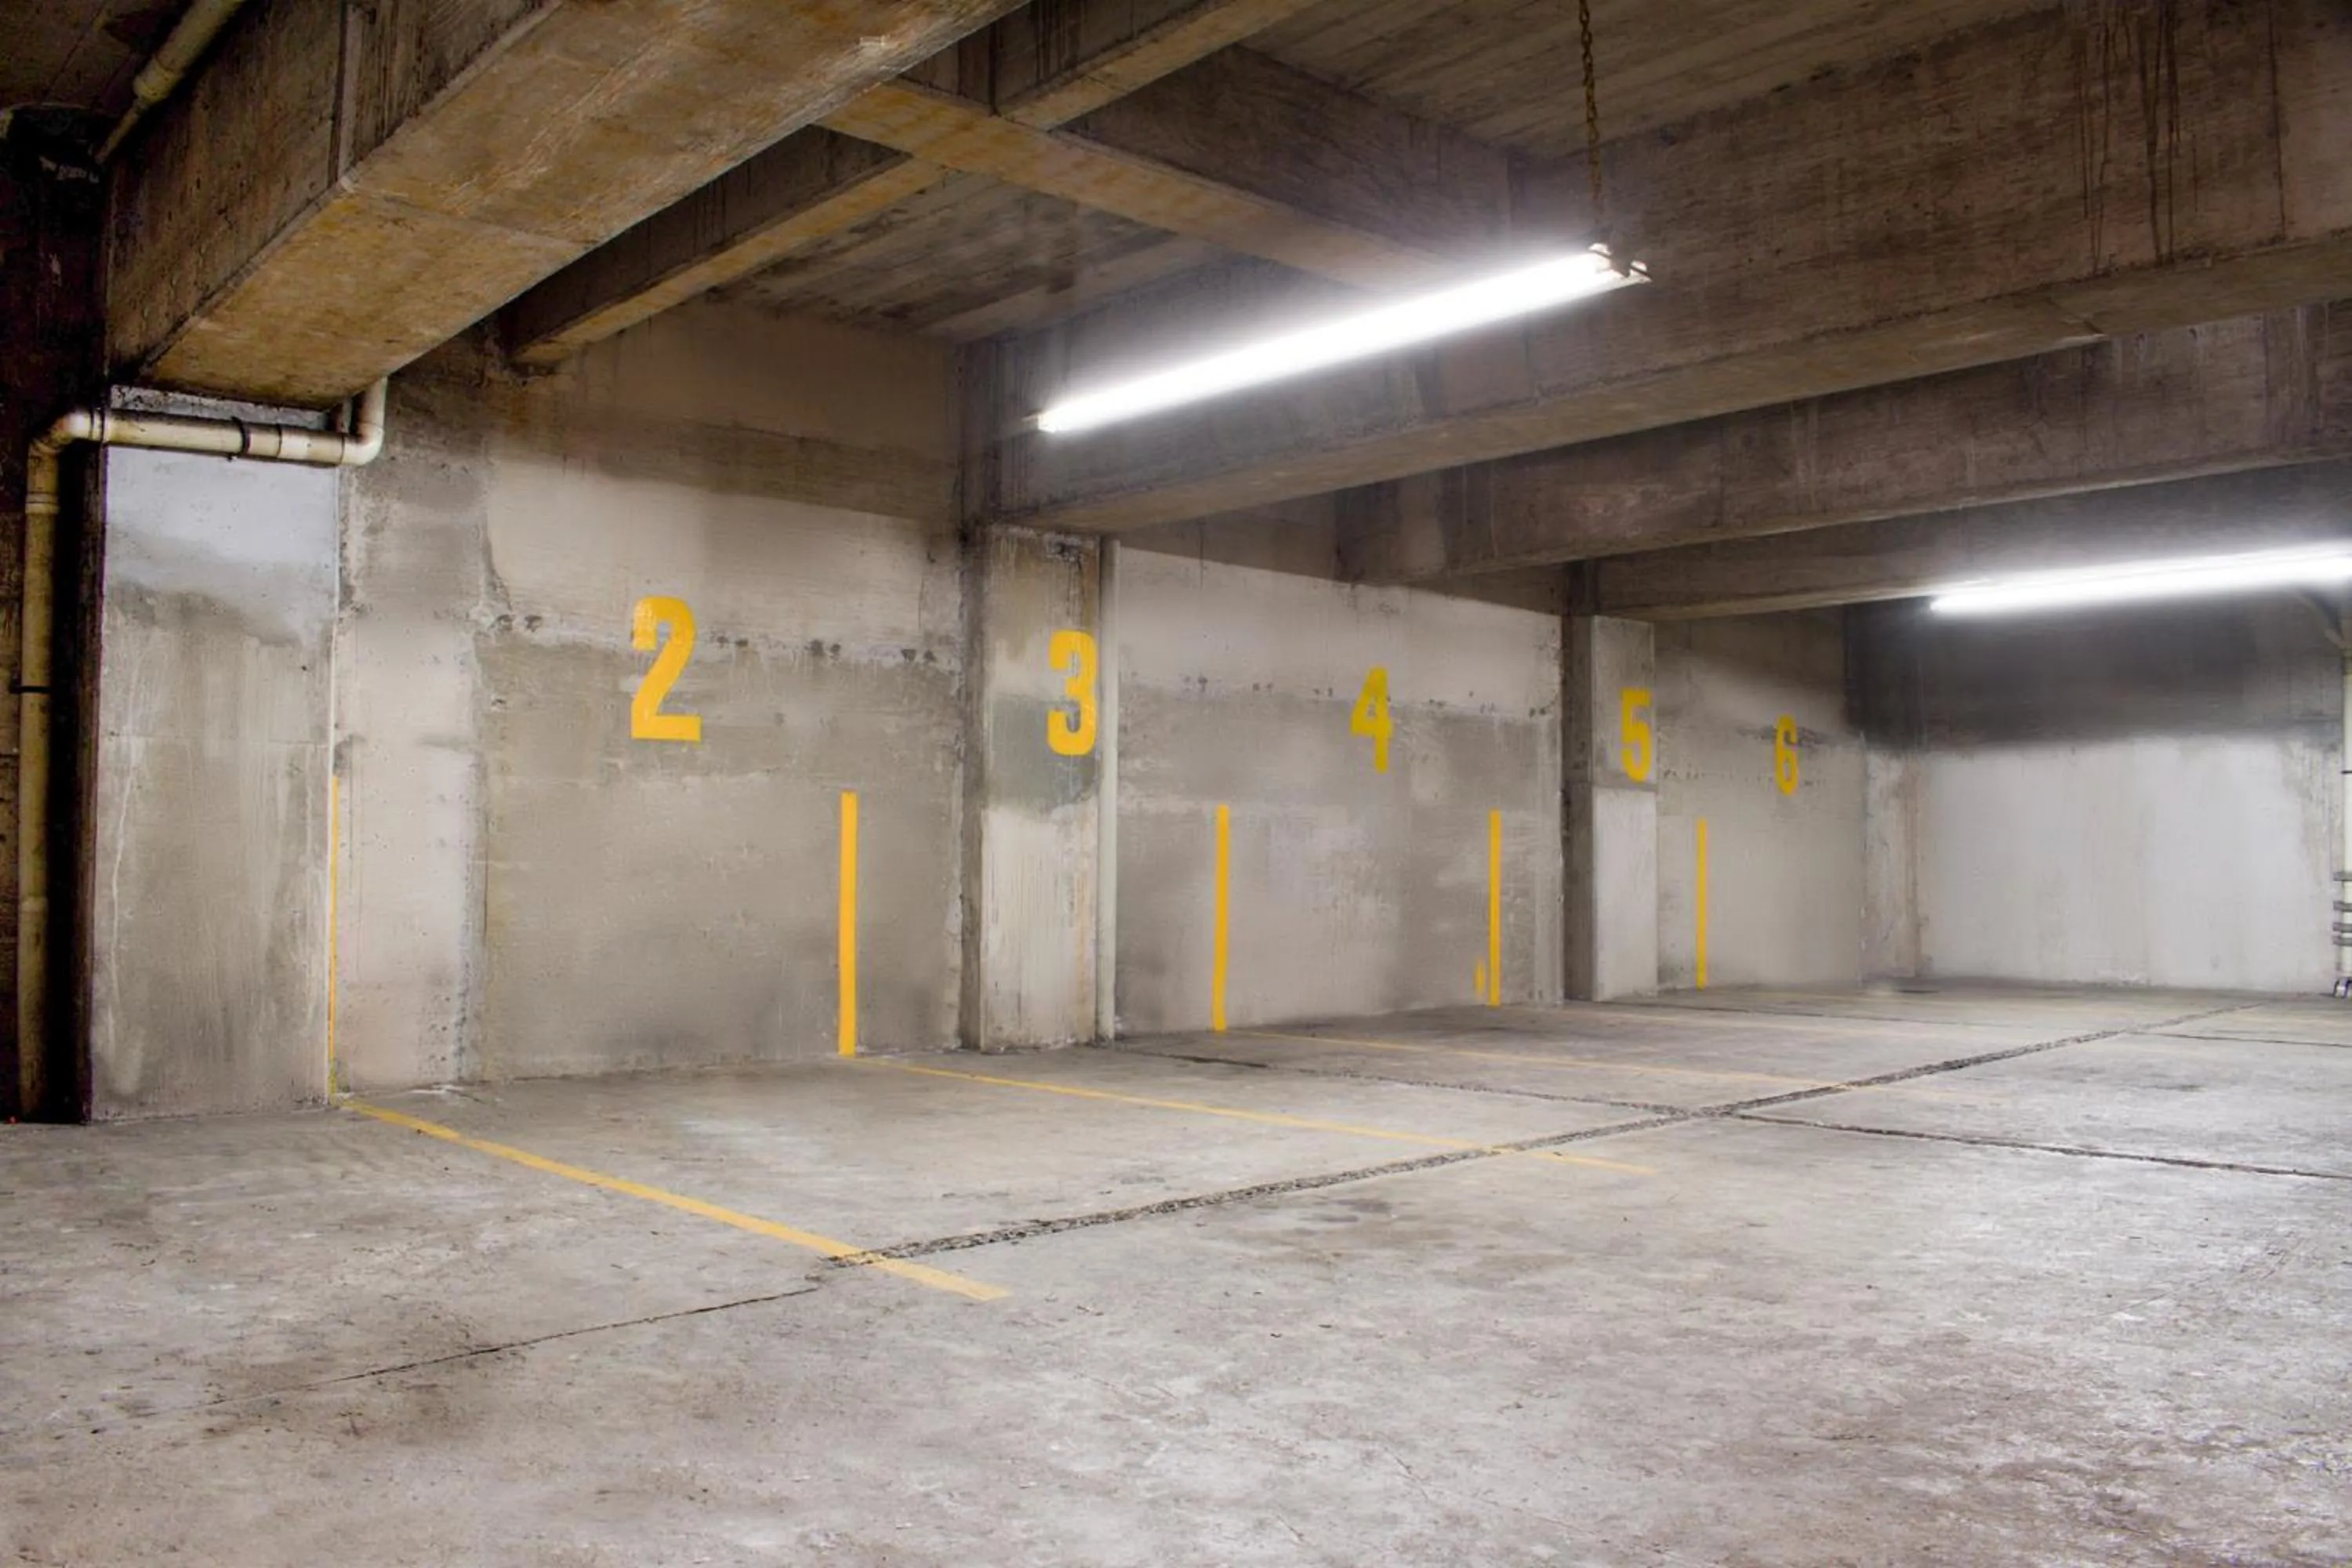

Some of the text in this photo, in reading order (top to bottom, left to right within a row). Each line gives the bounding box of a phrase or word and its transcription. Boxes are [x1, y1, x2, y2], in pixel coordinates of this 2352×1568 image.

[630, 596, 702, 742] 2
[1047, 629, 1097, 757] 3
[1349, 666, 1393, 774] 4
[1620, 687, 1652, 783] 5
[1774, 714, 1798, 797] 6
